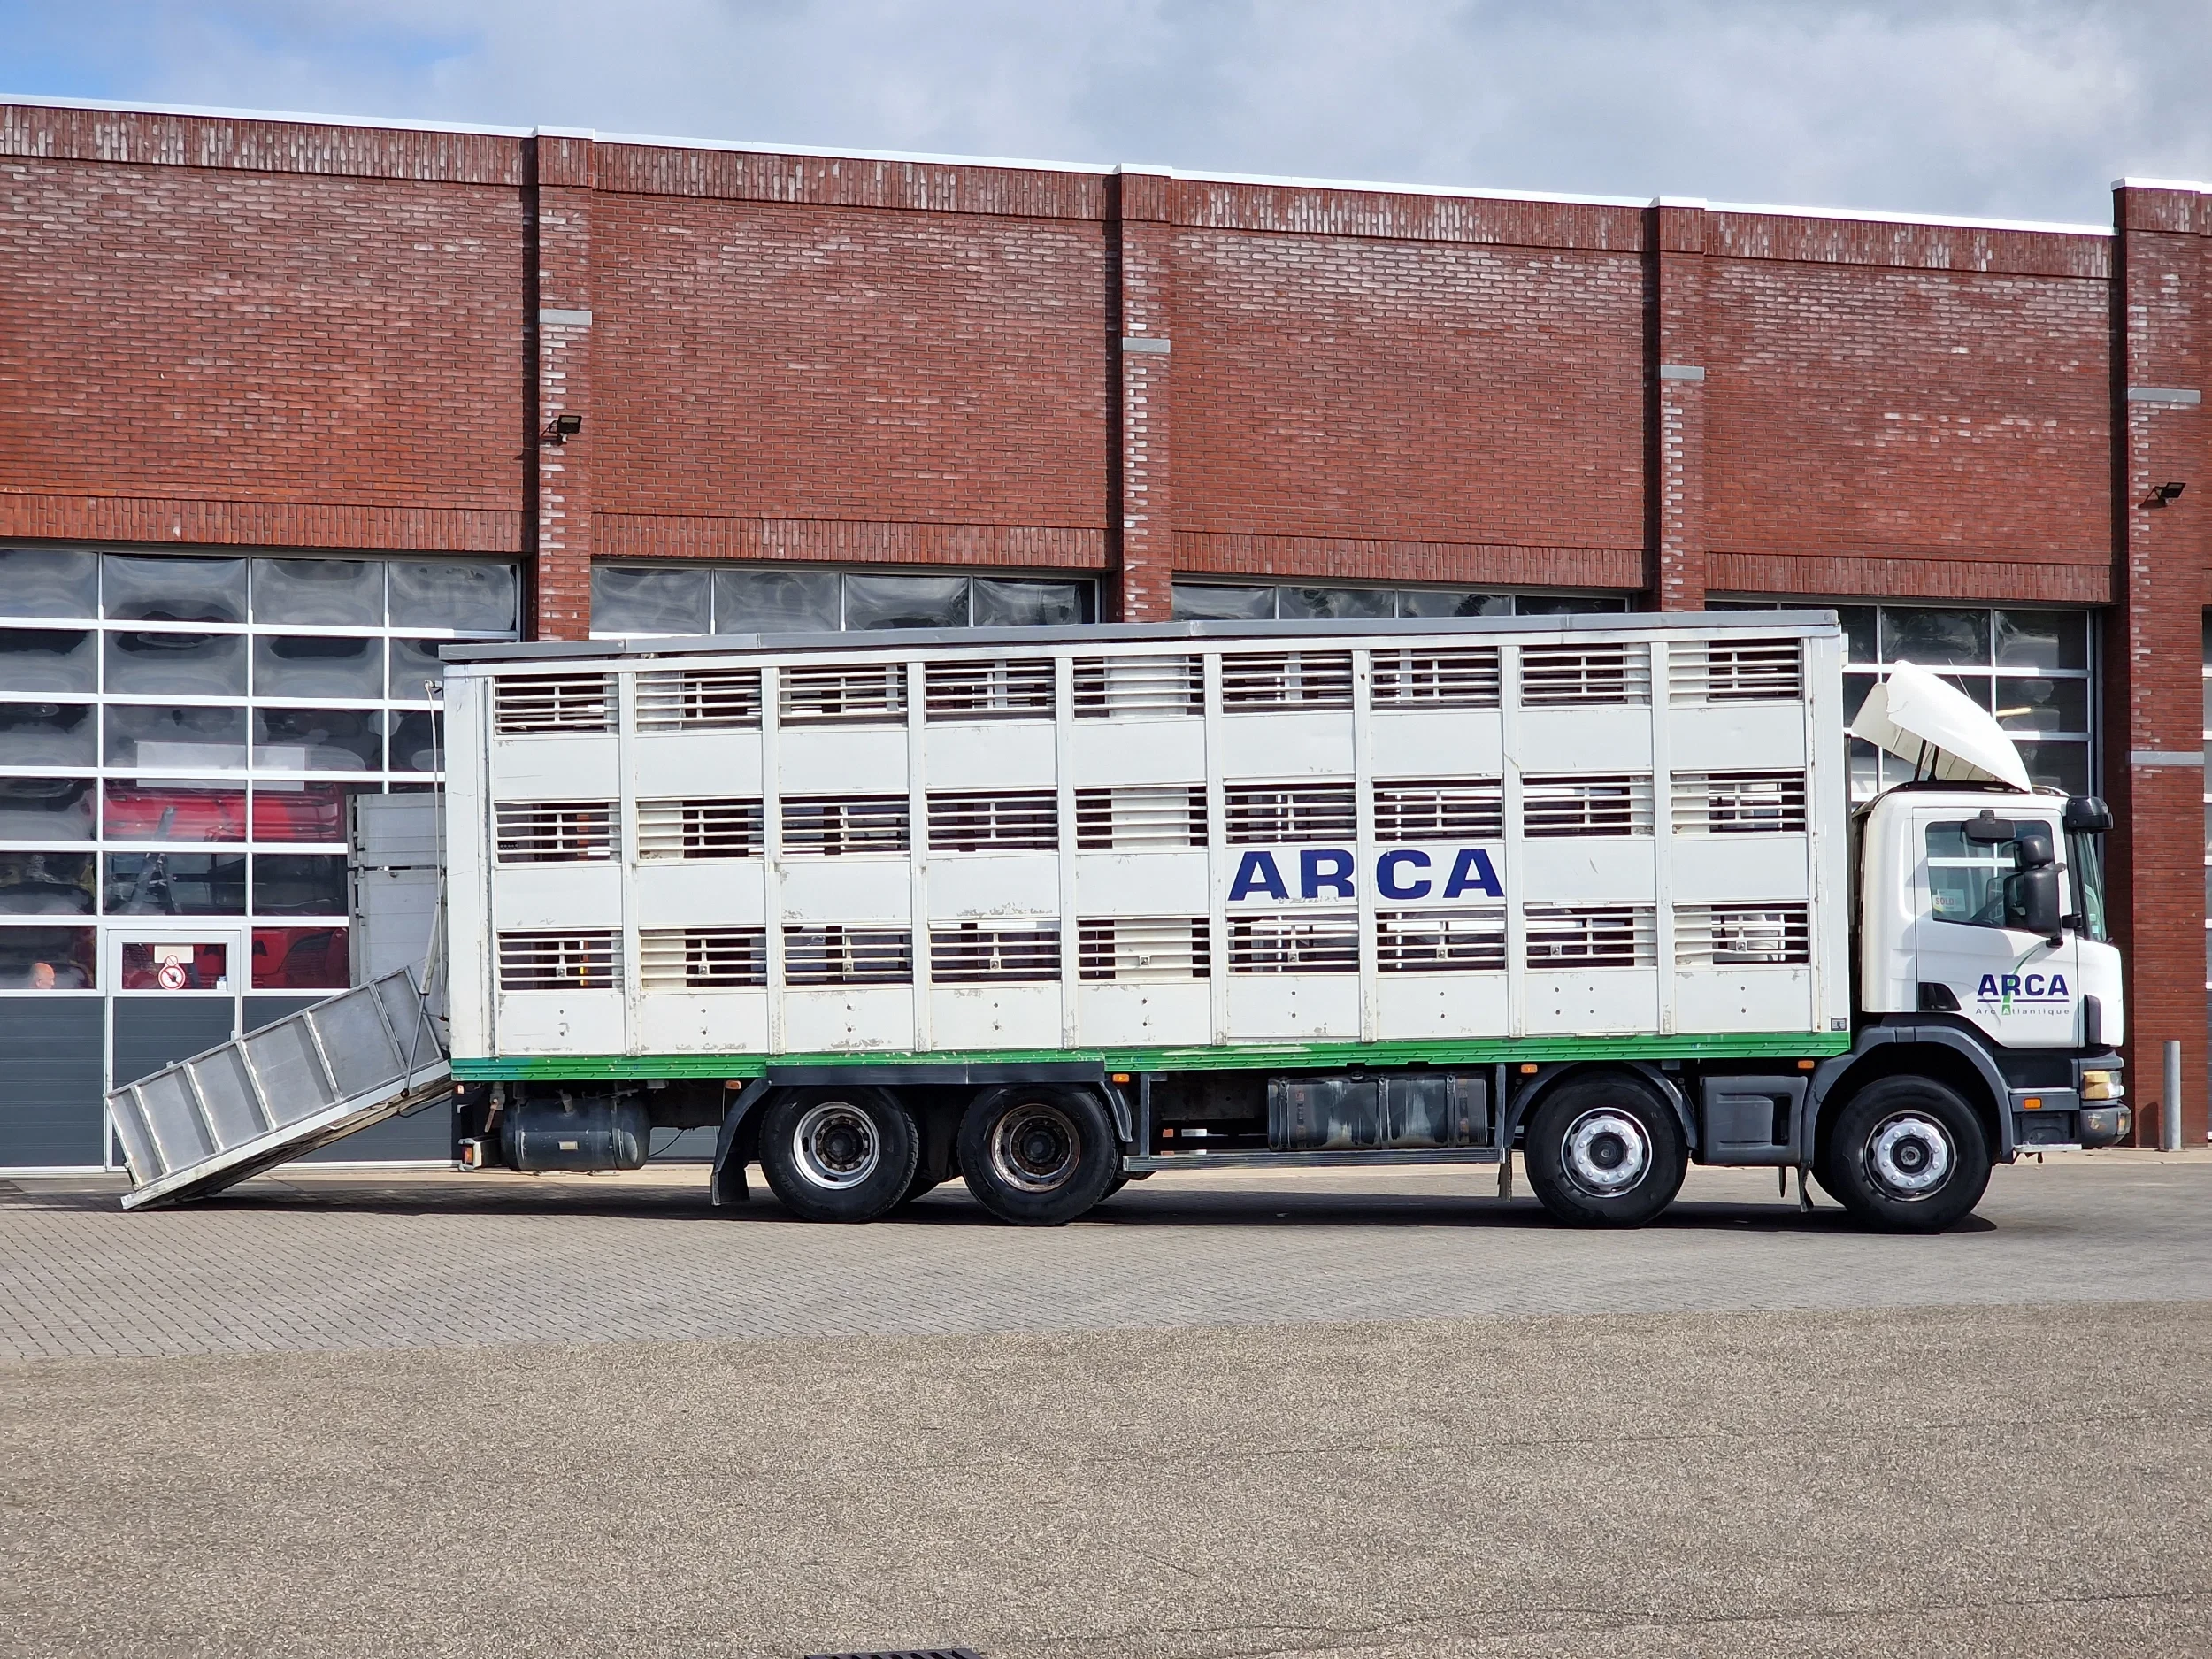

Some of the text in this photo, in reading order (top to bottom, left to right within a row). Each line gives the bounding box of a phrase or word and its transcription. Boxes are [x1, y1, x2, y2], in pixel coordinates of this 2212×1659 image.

[1227, 849, 1505, 901] ARCA
[1978, 974, 2069, 996] ARCA
[2002, 1006, 2070, 1016] Atlantique
